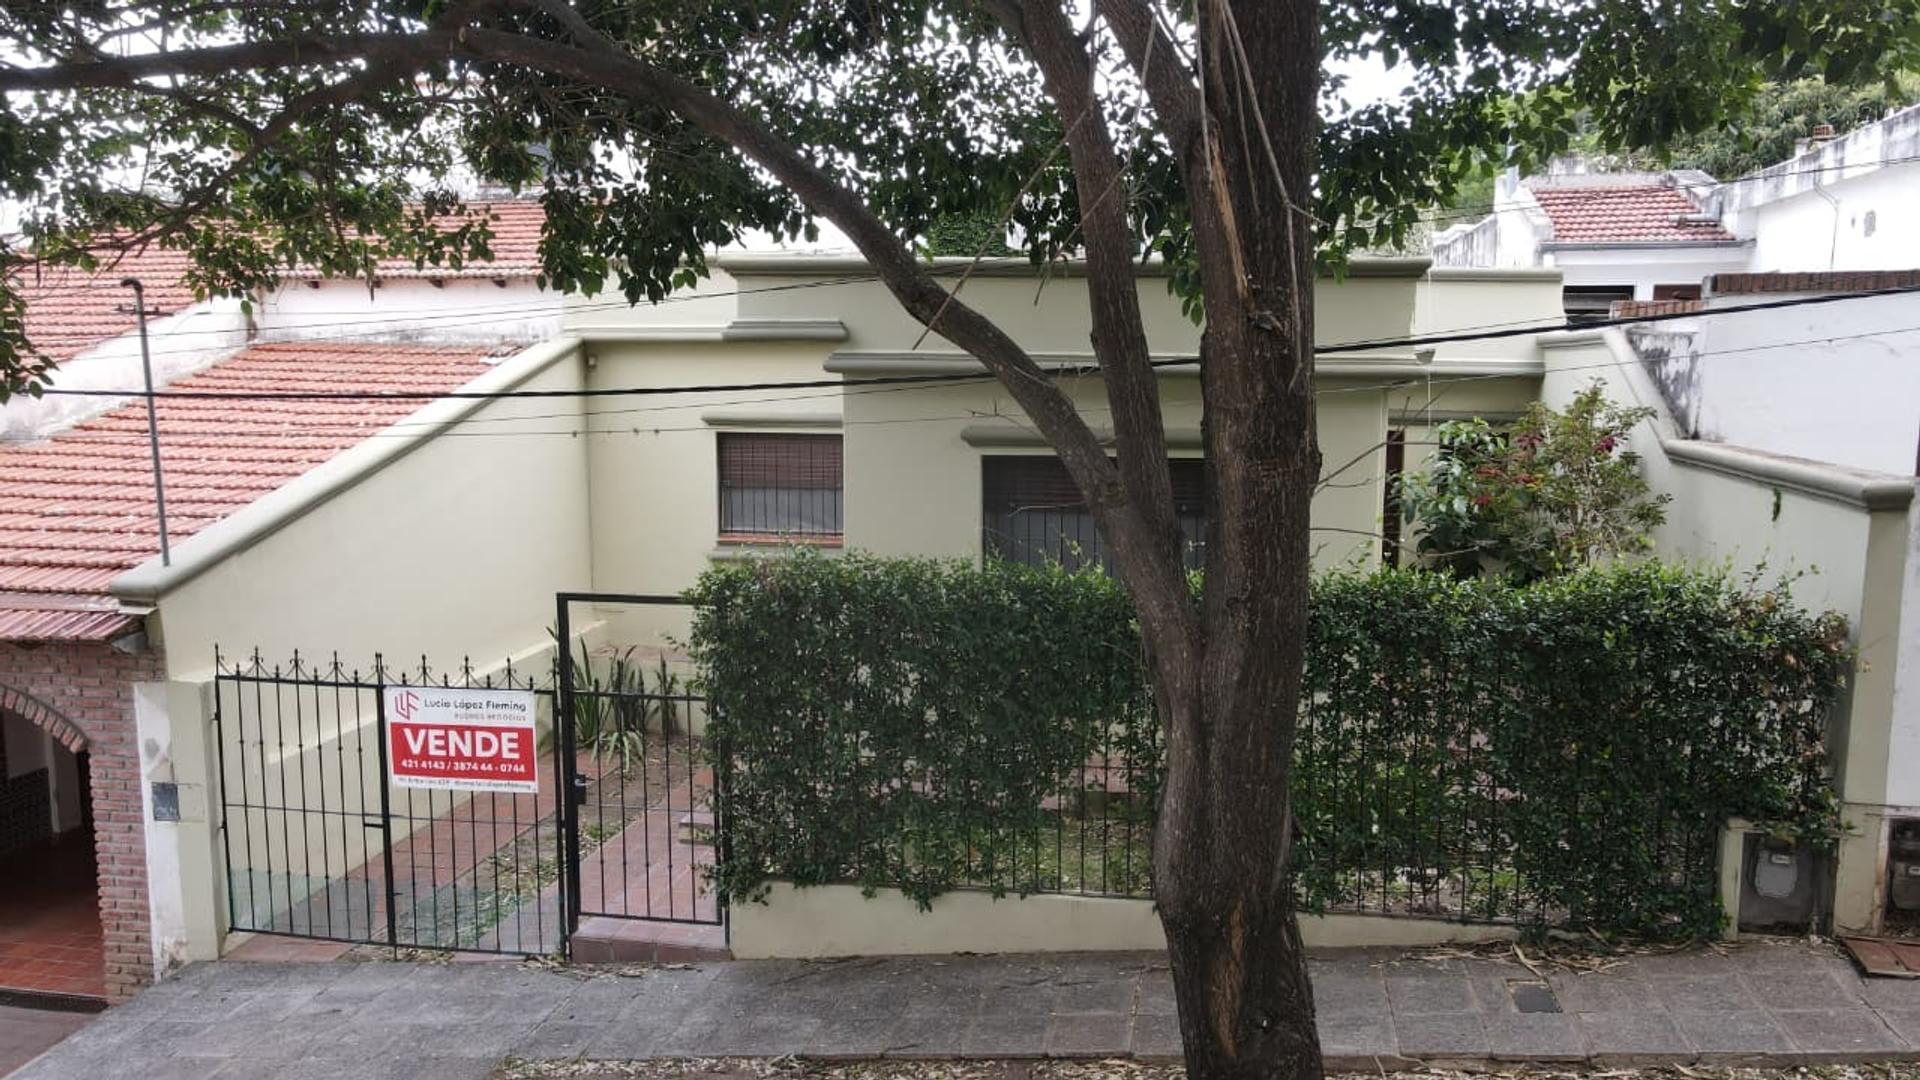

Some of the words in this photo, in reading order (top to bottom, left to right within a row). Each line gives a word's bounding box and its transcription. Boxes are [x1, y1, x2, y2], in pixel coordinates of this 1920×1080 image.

[486, 700, 527, 712] Fleming
[403, 727, 521, 760] VENDE
[401, 759, 419, 769] 421
[453, 761, 479, 771] 3874
[480, 763, 493, 772] 44
[500, 764, 526, 773] 0744
